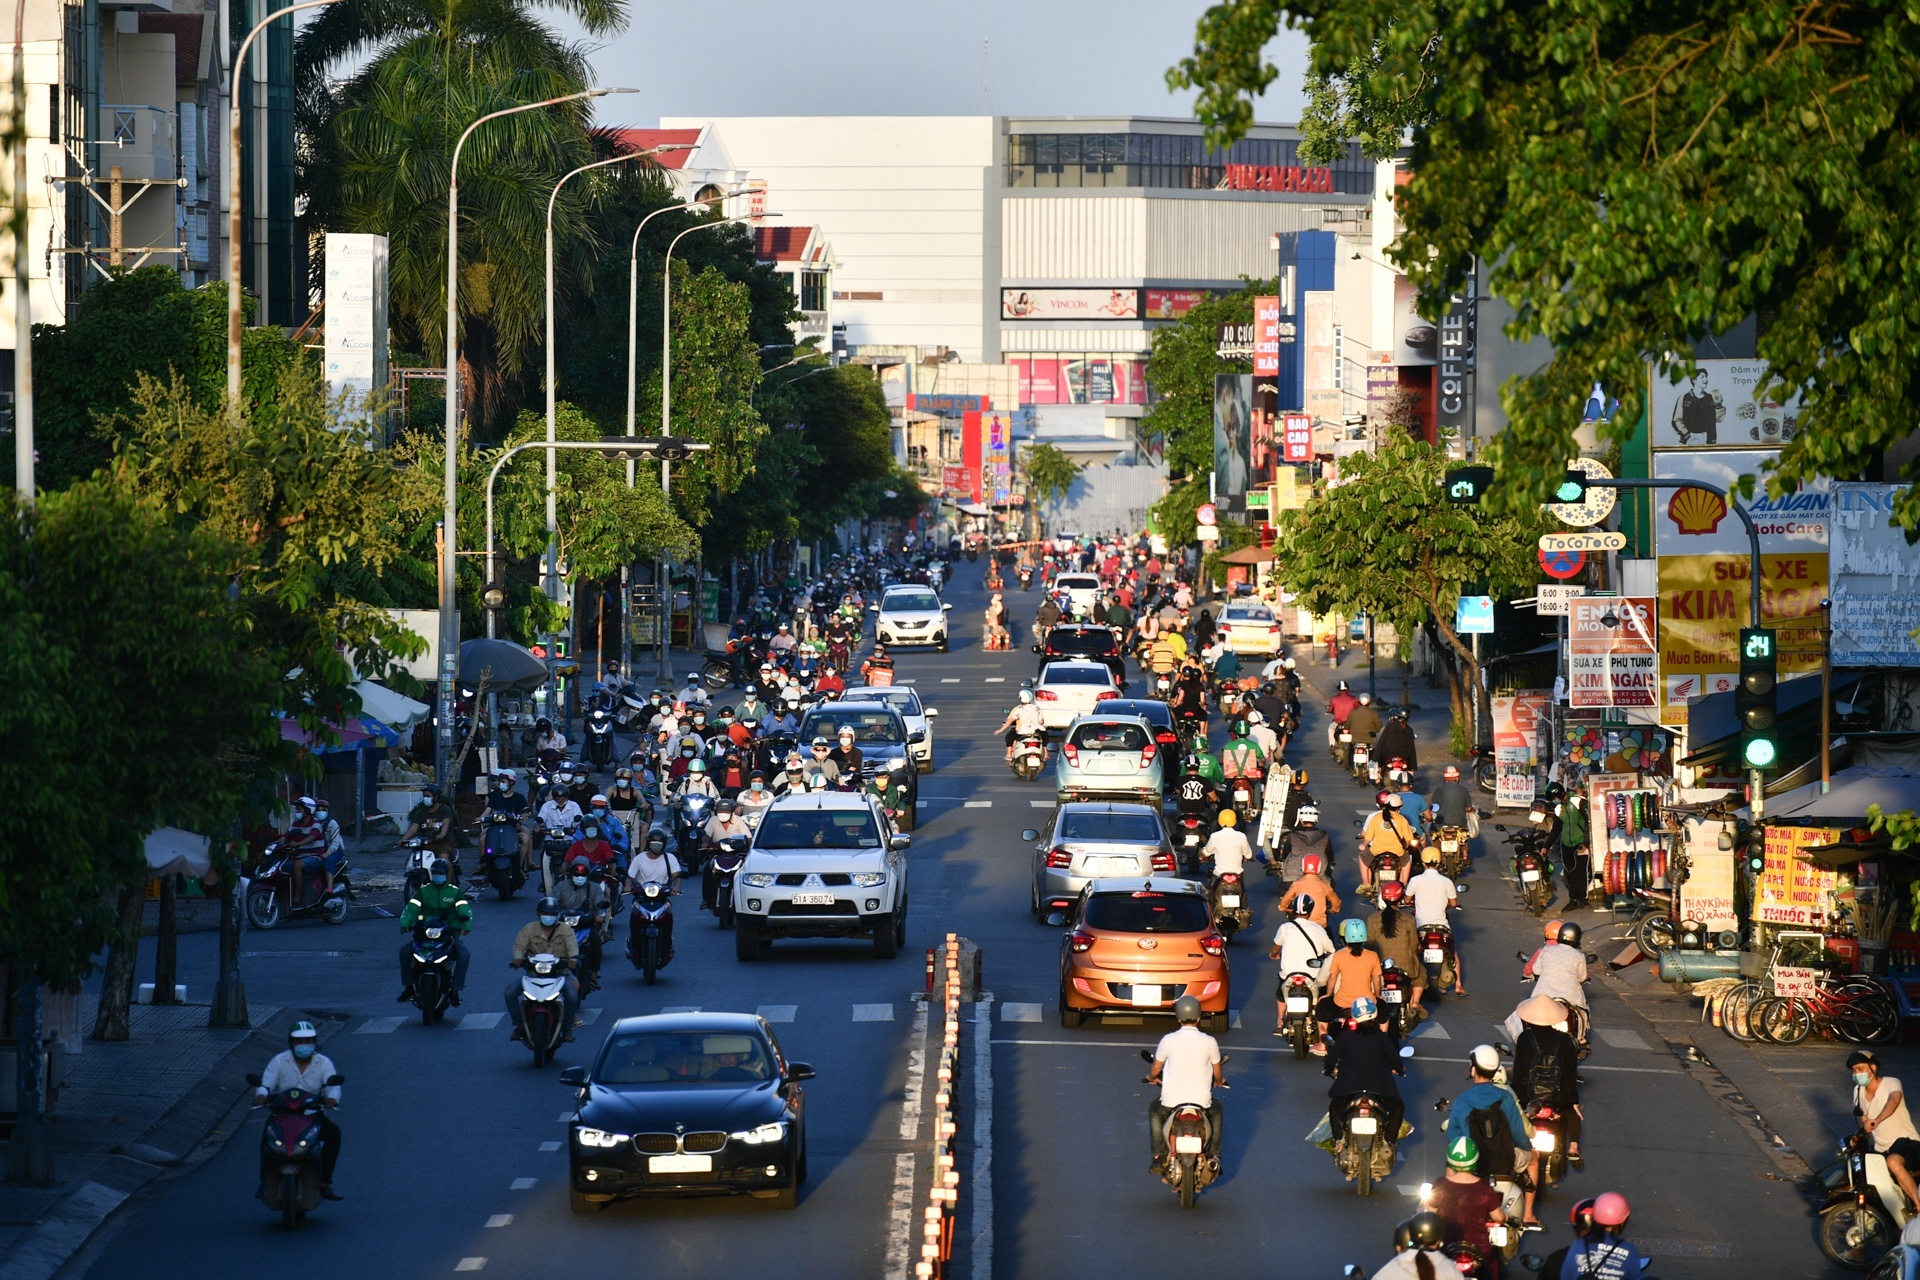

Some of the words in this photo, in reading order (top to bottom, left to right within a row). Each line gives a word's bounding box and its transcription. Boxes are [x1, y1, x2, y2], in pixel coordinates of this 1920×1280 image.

[1050, 300, 1088, 309] VINCOM
[1442, 315, 1462, 414] COFFEE
[1730, 366, 1750, 374] Đậm
[1752, 366, 1760, 374] vị
[1732, 377, 1752, 386] Trọn
[1288, 418, 1308, 430] BAO
[1288, 432, 1308, 444] CAO
[1292, 446, 1306, 457] SU
[1748, 494, 1828, 512] ADVAN
[1746, 522, 1822, 534] MotoCare
[1776, 560, 1808, 580] XE
[1542, 588, 1557, 598] 6:00
[1566, 589, 1580, 597] 9:00
[1540, 602, 1557, 610] 16:00
[1672, 589, 1736, 620] KIM
[1692, 629, 1736, 646] Chuyên:
[1746, 634, 1770, 658] 24
[1592, 658, 1603, 668] XE
[1666, 651, 1690, 664] Mua
[1574, 673, 1604, 688] KIM
[1610, 671, 1654, 688] NGÂN
[1668, 712, 1682, 721] 793
[1780, 828, 1792, 840] MÍA
[1763, 906, 1805, 922] THUỐC
[1778, 970, 1794, 978] MUA
